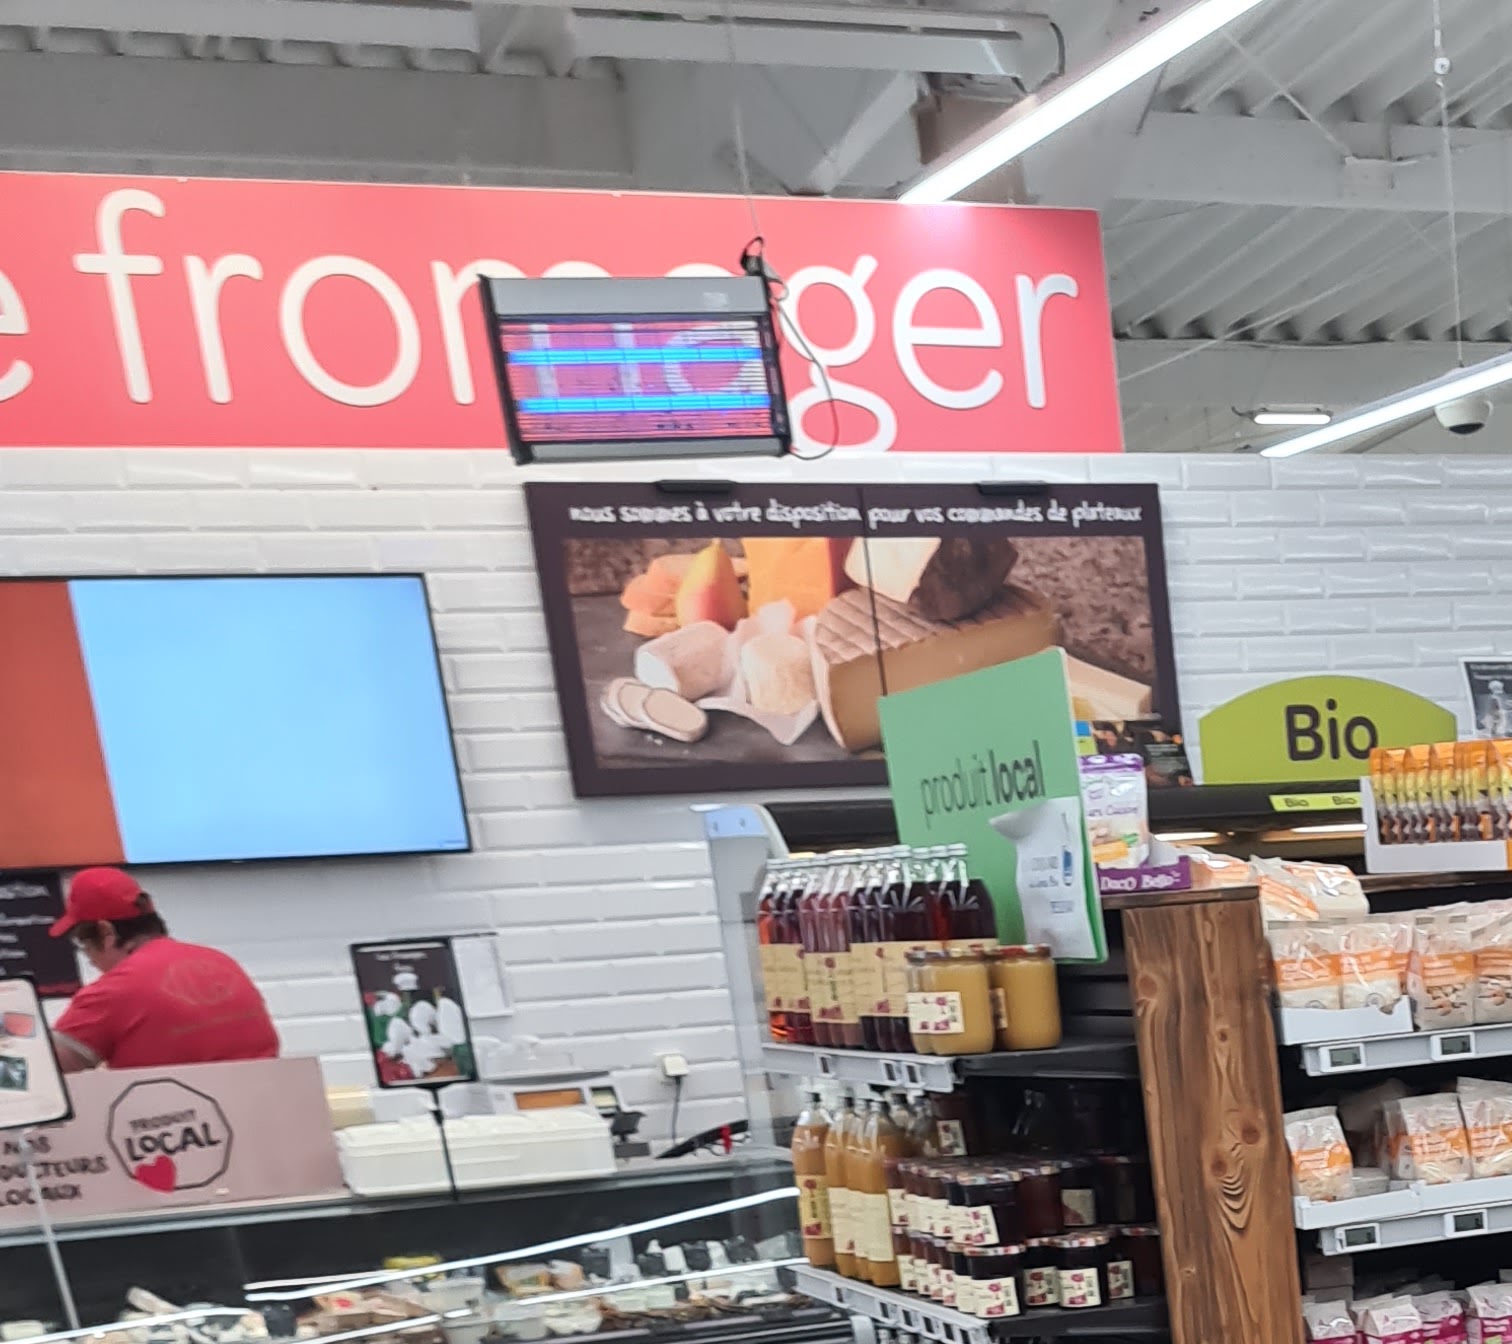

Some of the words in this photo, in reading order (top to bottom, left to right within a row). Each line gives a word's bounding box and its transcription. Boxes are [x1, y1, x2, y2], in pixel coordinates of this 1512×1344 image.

[569, 505, 617, 523] nous
[696, 499, 710, 522] à
[712, 502, 762, 522] votre
[766, 499, 862, 529] disposition
[868, 505, 909, 529] pour
[914, 505, 944, 523] vos
[947, 500, 1044, 522] commandes
[1046, 500, 1067, 521] de
[1284, 698, 1379, 761] Bio
[920, 753, 990, 830] produit
[989, 740, 1046, 807] local
[123, 1122, 223, 1161] LOCAL
